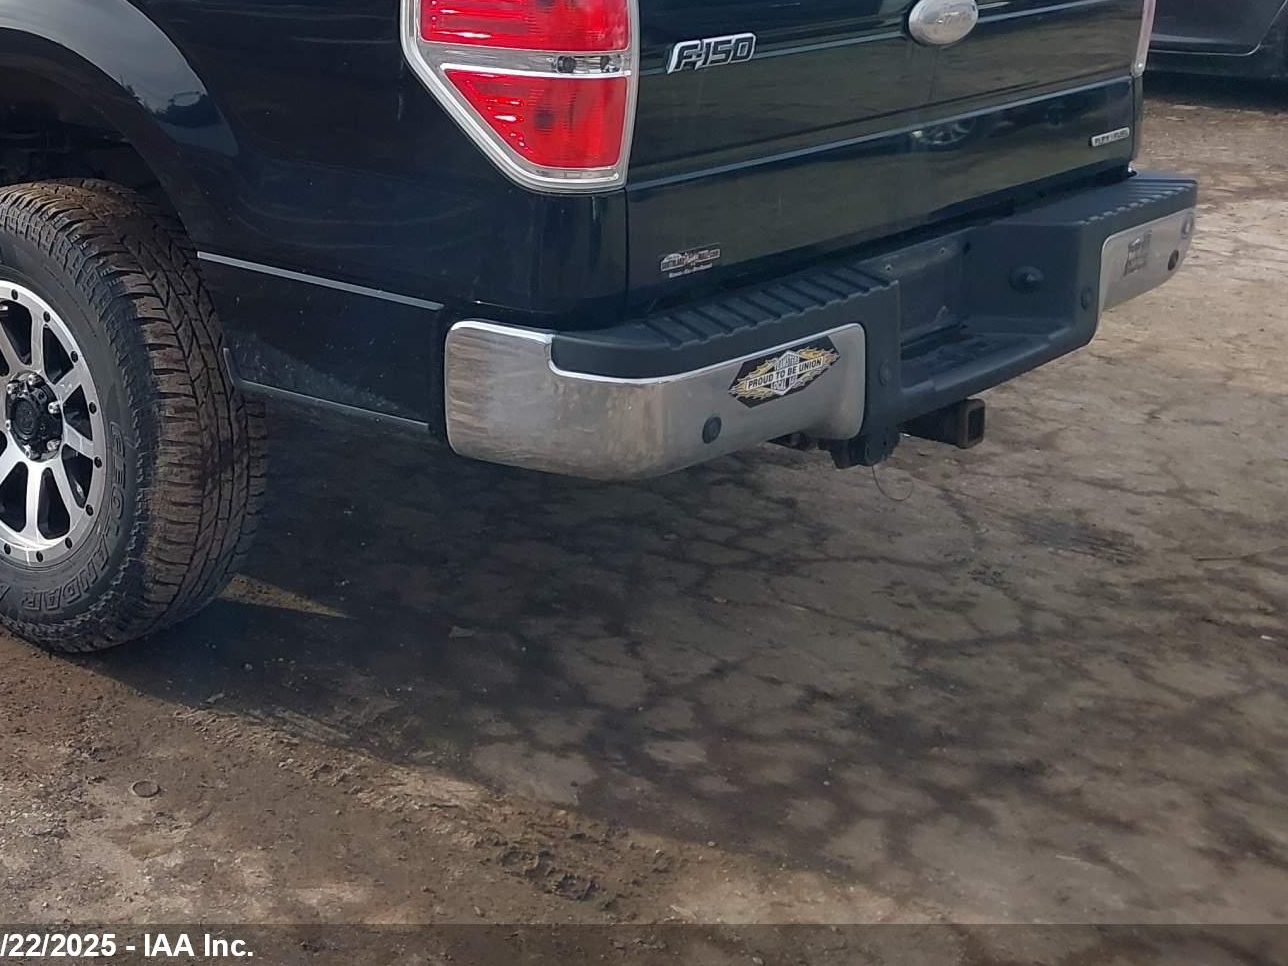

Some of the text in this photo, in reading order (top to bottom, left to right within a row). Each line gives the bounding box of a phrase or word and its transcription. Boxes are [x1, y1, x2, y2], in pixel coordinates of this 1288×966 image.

[667, 32, 757, 75] F-150
[747, 374, 774, 388] PROUD
[775, 370, 786, 381] TO
[787, 367, 797, 377] BE
[798, 357, 823, 372] UNION
